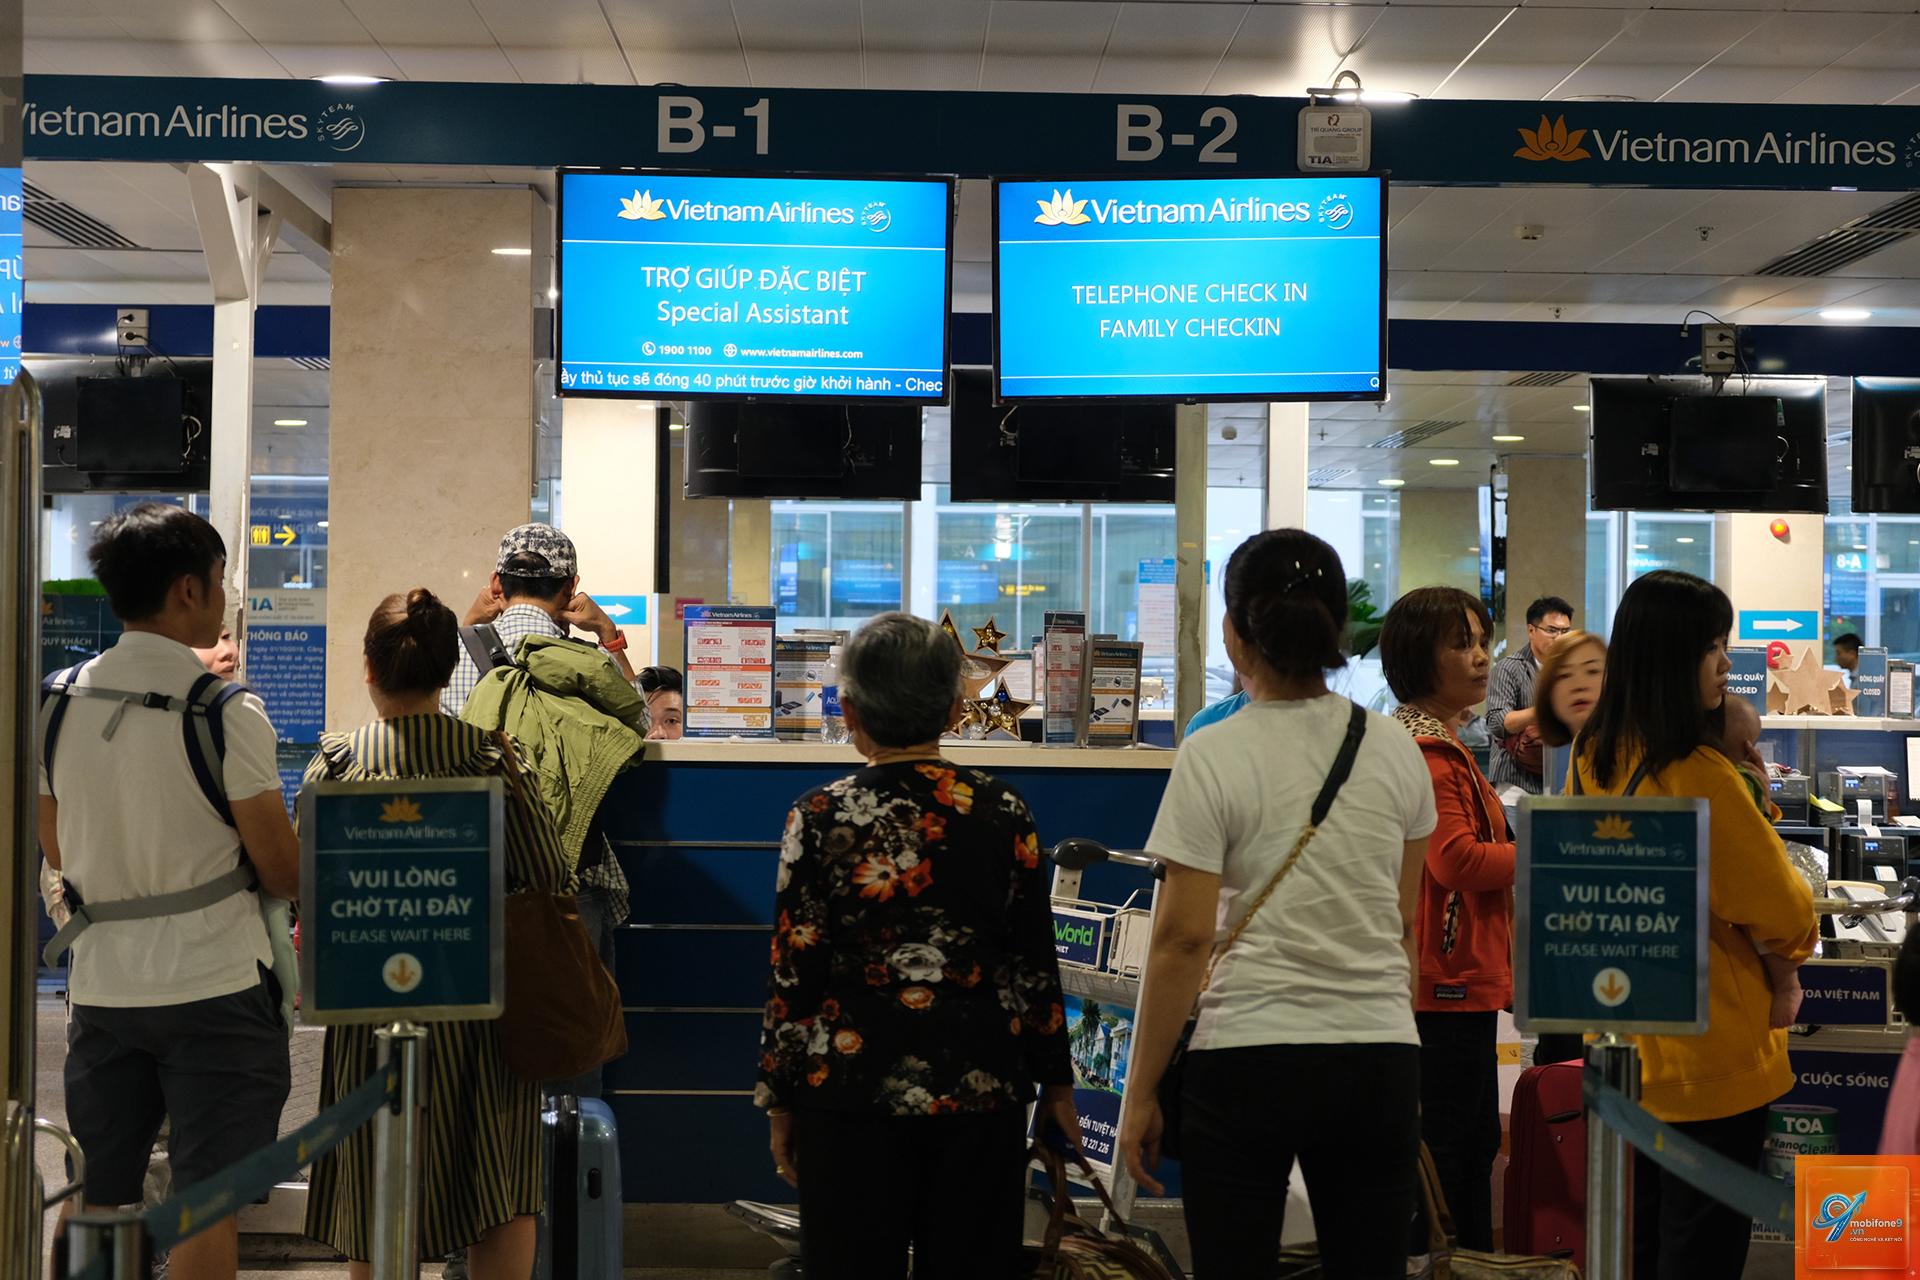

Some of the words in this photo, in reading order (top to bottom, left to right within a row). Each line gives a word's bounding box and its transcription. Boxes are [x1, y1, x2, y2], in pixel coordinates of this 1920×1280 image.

[657, 95, 769, 155] B-1
[1116, 104, 1238, 163] B-2
[1308, 155, 1332, 164] TIA
[641, 265, 691, 292] TRỢ
[696, 264, 753, 290] GIÚP
[759, 265, 811, 295] ĐẶC
[817, 267, 867, 296] BIỆT
[1072, 283, 1198, 304] TELEPHONE
[1206, 282, 1278, 303] CHECK
[1284, 282, 1307, 302] IN
[657, 300, 739, 326] Special
[746, 302, 849, 325] Assistant
[1100, 318, 1179, 338] FAMILY
[1185, 317, 1281, 337] CHECKIN
[659, 345, 685, 355] 1900
[687, 345, 712, 356] 1100
[741, 346, 864, 359] www.vietnamairlines.com
[581, 369, 603, 385] thủ
[607, 372, 629, 387] tục
[633, 370, 651, 386] sẽ
[654, 371, 690, 390] đóng
[693, 373, 712, 387] 40
[716, 371, 747, 391] phút
[750, 373, 790, 389] trước
[793, 375, 818, 393] giờ
[820, 372, 852, 390] khởi
[855, 373, 891, 391] hành
[285, 629, 308, 641] BÁO
[348, 869, 388, 888] VUI
[394, 866, 457, 888] LÒNG
[1562, 885, 1599, 903] VUI
[1605, 882, 1665, 904] LÒNG
[331, 896, 381, 918] CHỜ
[384, 898, 420, 921] TẠI
[426, 894, 472, 916] ĐÂY
[1544, 910, 1593, 932] CHỜ
[1596, 915, 1630, 937] TẠI
[1636, 912, 1680, 933] ĐÂY
[332, 929, 386, 943] PLEASE
[391, 928, 429, 942] WAIT
[433, 928, 471, 941] HERE
[1545, 943, 1598, 957] PLEASE
[1601, 944, 1638, 957] WAIT
[1642, 945, 1679, 958] HERE
[1824, 988, 1850, 1001] VIỆT
[1852, 991, 1880, 1000] NAM
[1801, 1072, 1843, 1089] CUỘC
[1846, 1072, 1889, 1088] SỐNG
[1782, 1116, 1824, 1134] TOA
